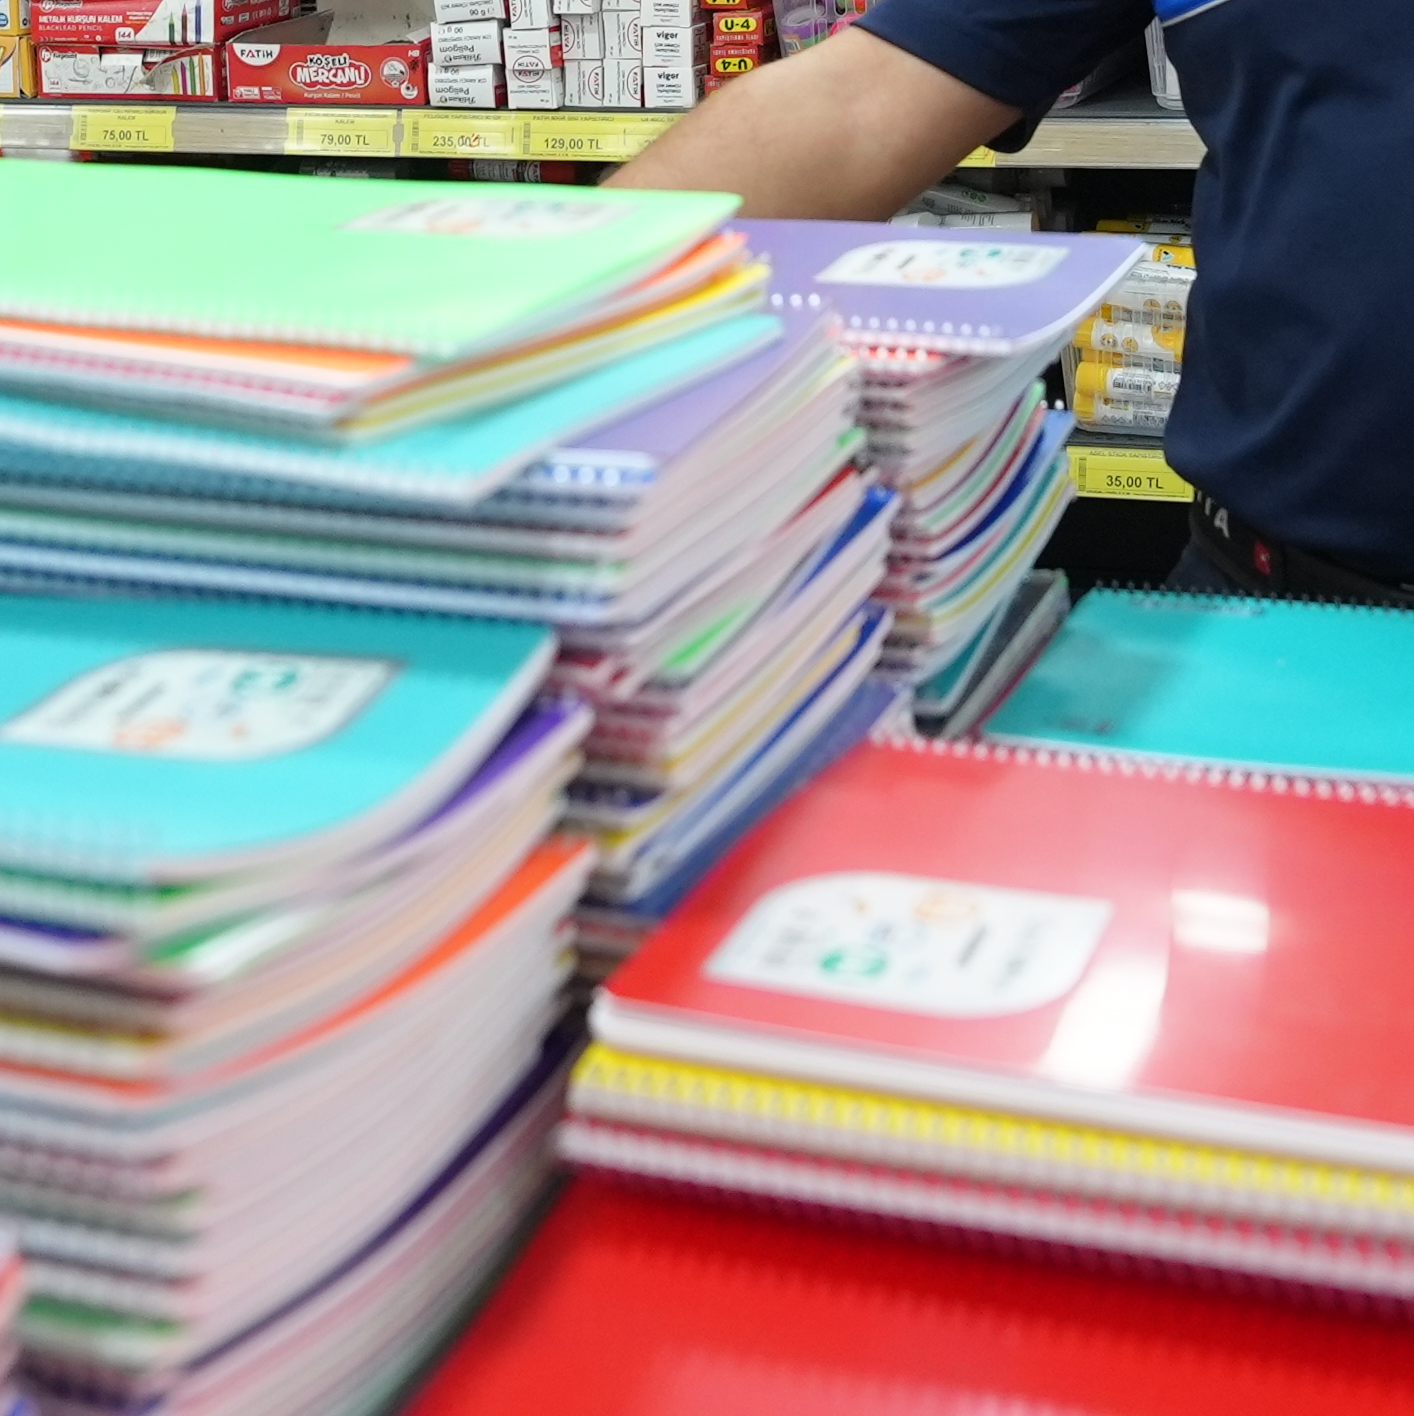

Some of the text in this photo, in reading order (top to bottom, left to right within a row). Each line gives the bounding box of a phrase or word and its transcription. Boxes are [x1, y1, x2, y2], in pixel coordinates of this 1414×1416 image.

[97, 14, 123, 23] KALEM
[469, 8, 479, 17] 90
[38, 25, 75, 33] BLACKLEAD
[723, 18, 751, 31] U-4
[118, 30, 132, 39] 144
[655, 30, 679, 42] vigor
[439, 44, 475, 54] Peligom
[720, 59, 748, 72] U-4
[296, 66, 365, 85] MERCANLI
[656, 70, 680, 82] vigor
[435, 87, 470, 96] Peligom
[102, 130, 149, 142] 75,00 TL
[320, 134, 370, 147] 79,00 TL
[544, 138, 603, 152] 129,00 TL
[1106, 474, 1164, 489] 35,00 TL
